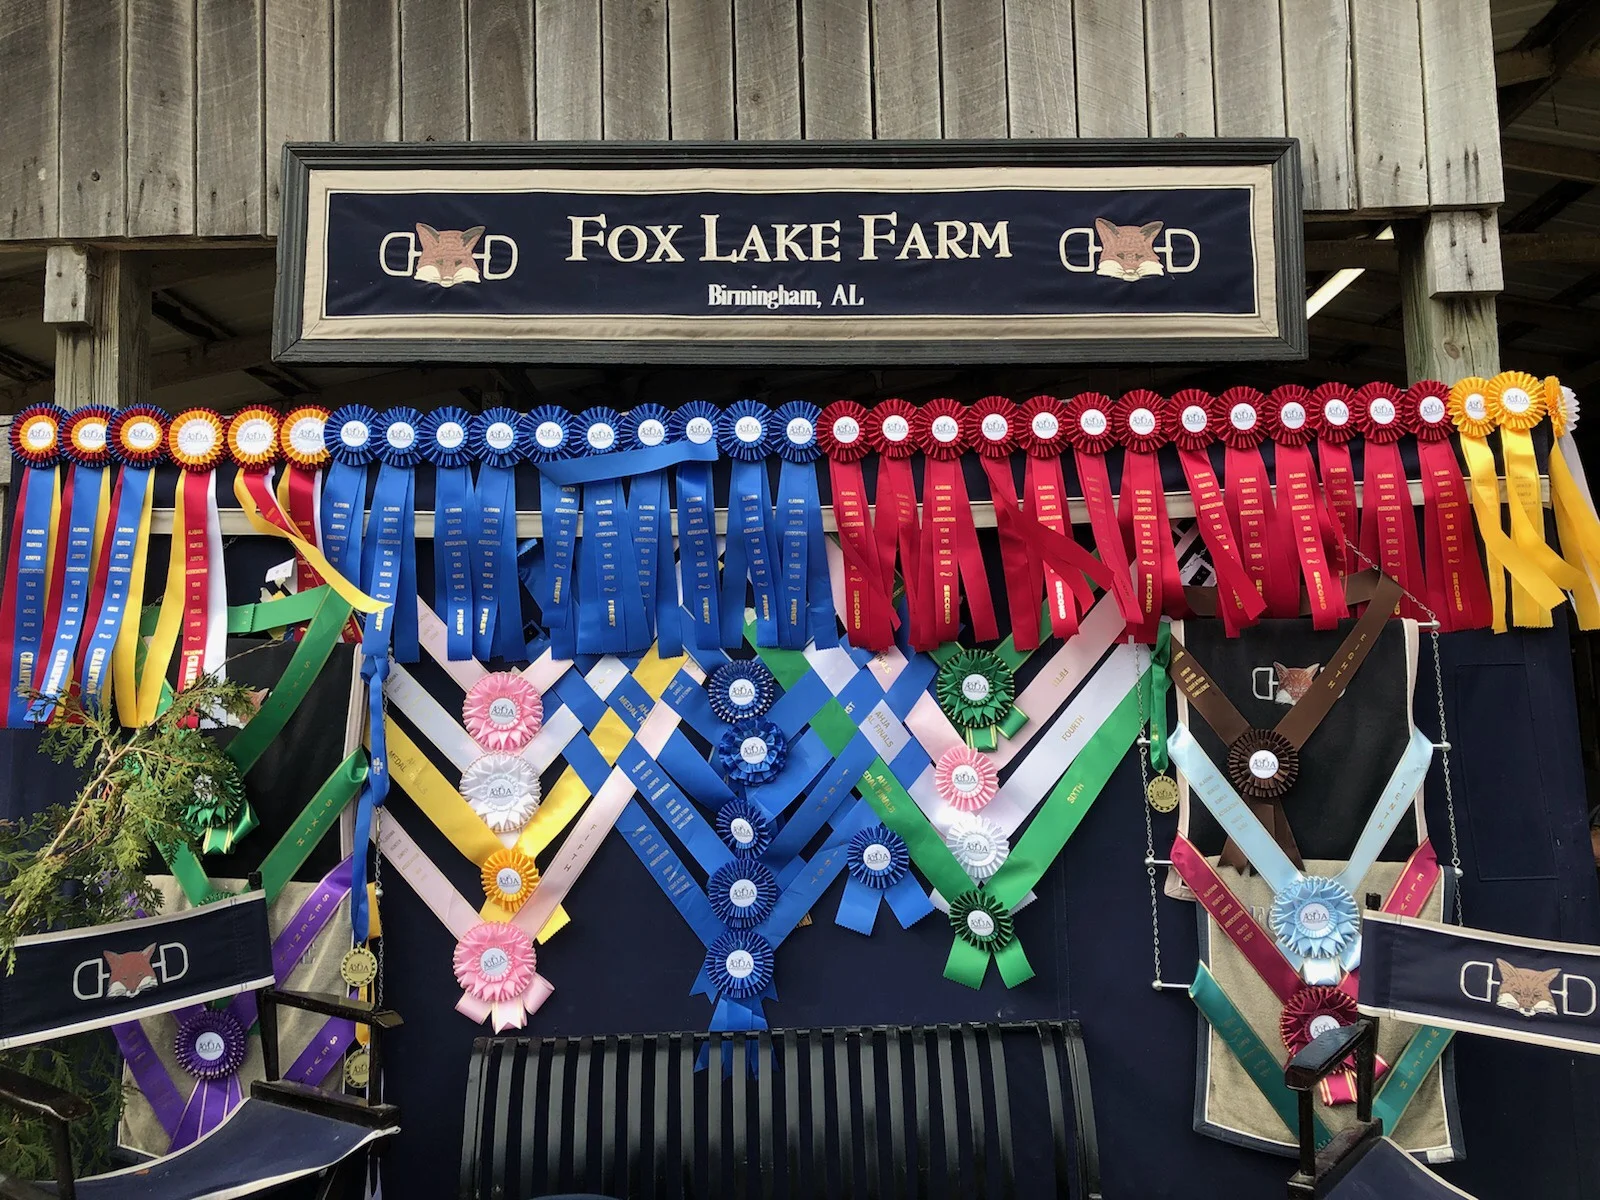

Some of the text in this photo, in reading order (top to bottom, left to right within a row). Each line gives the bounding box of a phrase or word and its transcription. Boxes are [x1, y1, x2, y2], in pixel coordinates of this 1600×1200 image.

[565, 211, 1013, 262] FOX LAKE FARM
[708, 283, 864, 309] Birmingham, AL
[853, 590, 861, 629] SECOND
[943, 585, 951, 624] SECOND
[1055, 581, 1066, 620] SECOND
[1313, 571, 1326, 610] SECOND
[1452, 572, 1463, 611] SECOND
[375, 609, 385, 632] IRST
[479, 608, 489, 636] FIRST
[607, 600, 616, 627] FIRST
[1327, 633, 1367, 689] EIGHTH
[873, 725, 894, 748] FINALS
[875, 710, 891, 729] AHJA
[1061, 714, 1085, 741] FOURTH
[1066, 782, 1085, 804] SIXTH
[1377, 782, 1406, 831] TENTH
[296, 799, 333, 847] SIXTH
[564, 824, 597, 871] FIFTH
[1400, 873, 1425, 911] ELEV
[305, 1035, 338, 1076] SEVE
